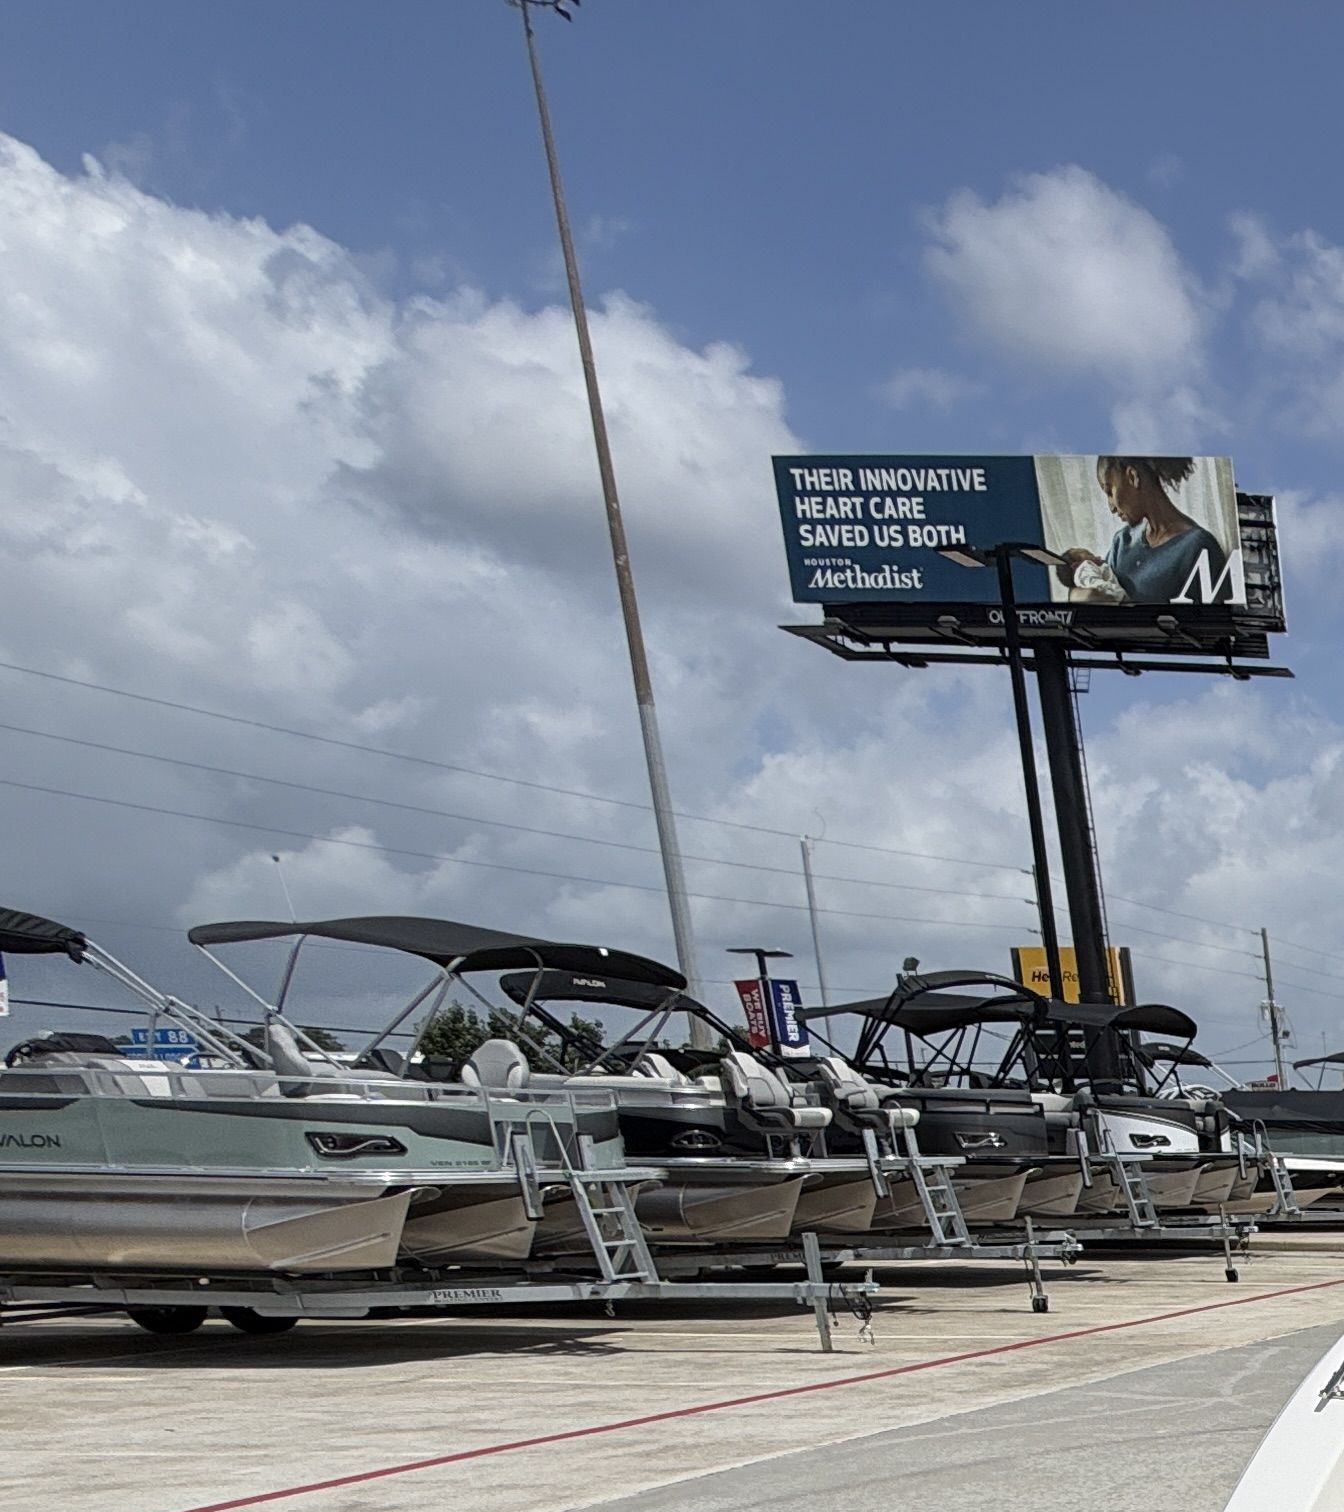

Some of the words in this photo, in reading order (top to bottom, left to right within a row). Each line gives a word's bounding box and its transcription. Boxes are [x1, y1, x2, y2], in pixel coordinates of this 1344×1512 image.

[789, 468, 855, 491] THEIR
[859, 468, 987, 491] INNOVATIVE
[795, 497, 864, 519] HEART
[869, 497, 926, 519] CARE
[799, 525, 869, 547] SAVED
[874, 525, 904, 547] US
[908, 525, 966, 547] BOTH
[804, 558, 851, 566] HOUSTON
[808, 564, 924, 589] Methodist
[743, 994, 758, 1034] BOATS
[751, 988, 761, 1010] WE
[756, 1012, 767, 1038] BUY
[779, 984, 800, 1042] PREMIER
[167, 1031, 188, 1043] 88
[432, 1289, 501, 1299] PREMIER
